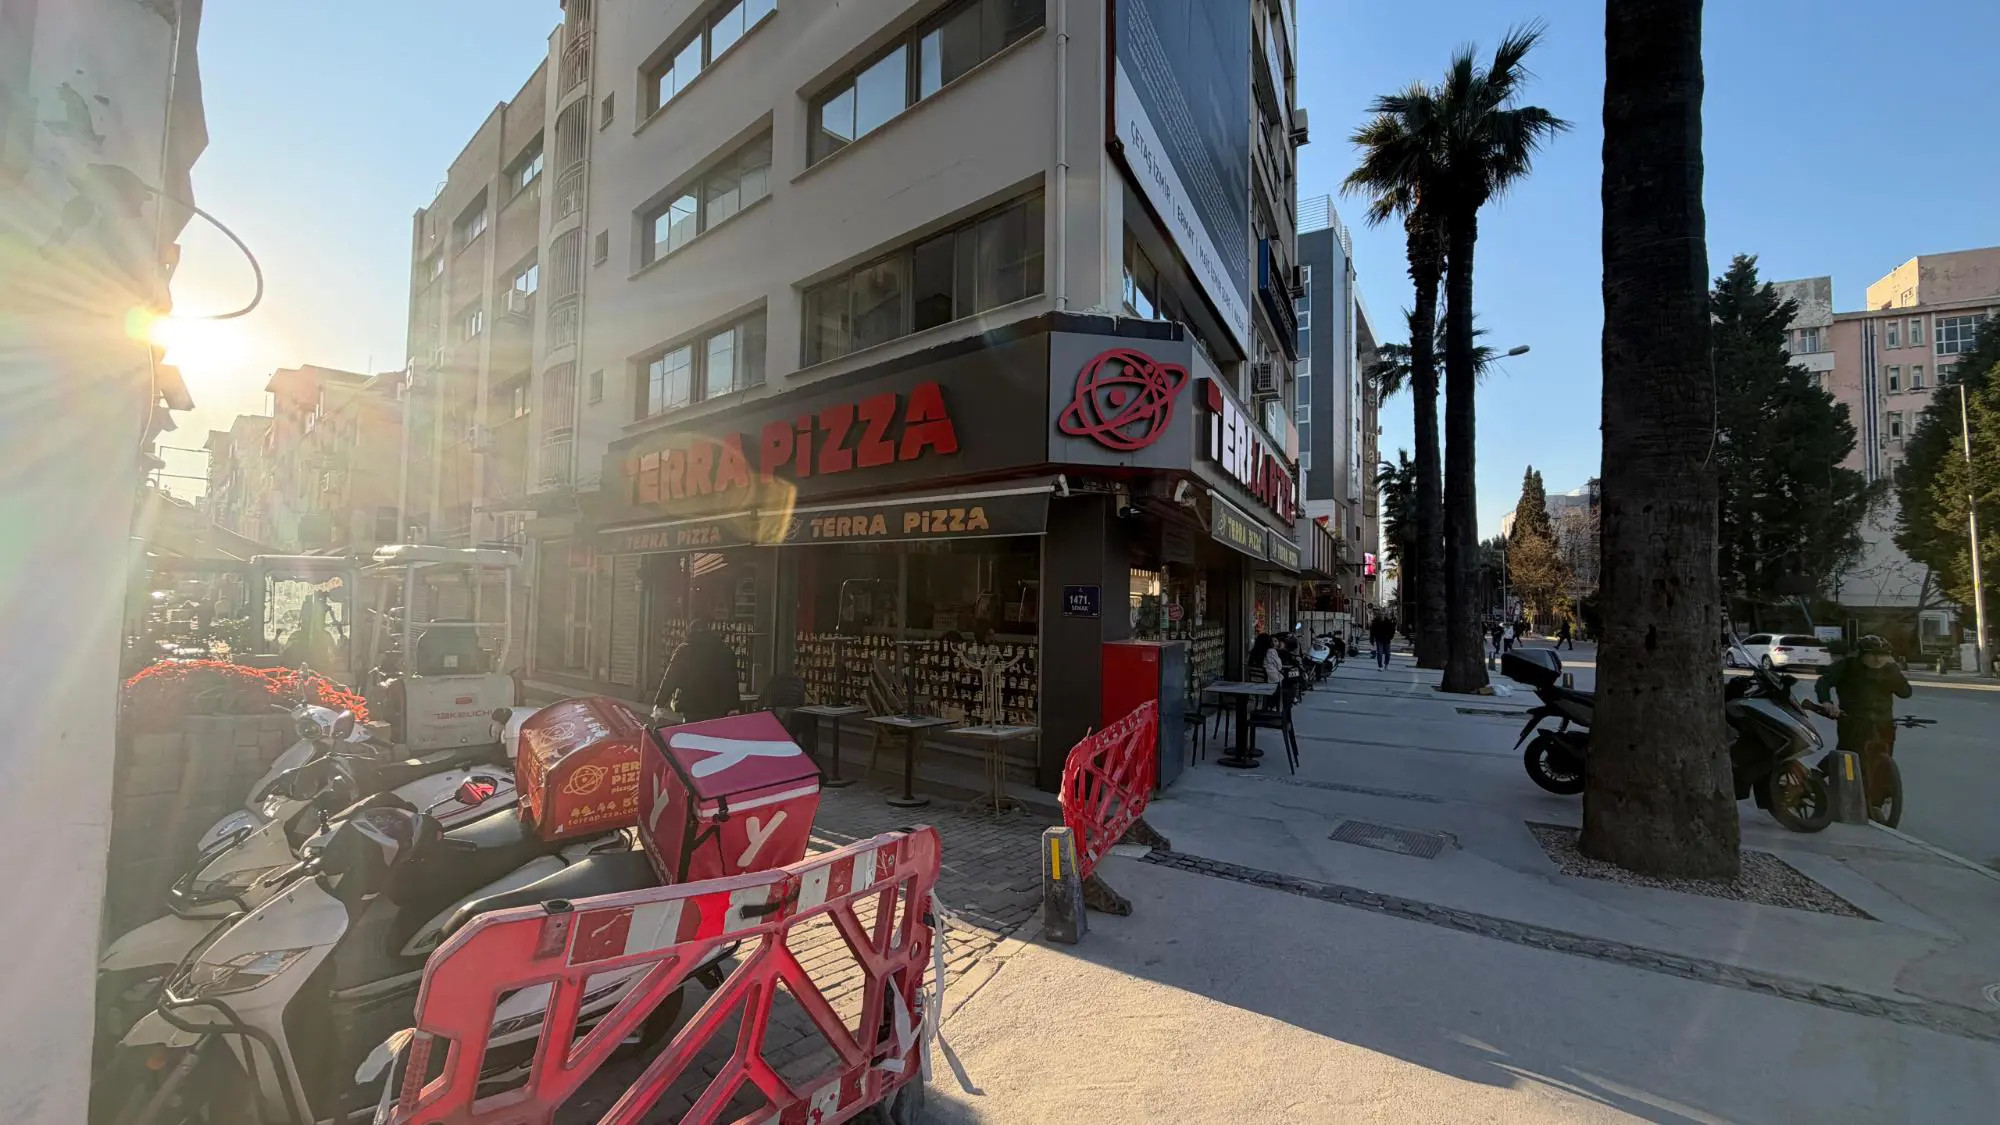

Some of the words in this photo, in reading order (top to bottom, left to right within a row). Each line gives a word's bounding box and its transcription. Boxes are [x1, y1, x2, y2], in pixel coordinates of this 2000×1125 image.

[623, 432, 749, 505] TERRA
[810, 513, 887, 538] TERRA
[612, 761, 641, 773] TER
